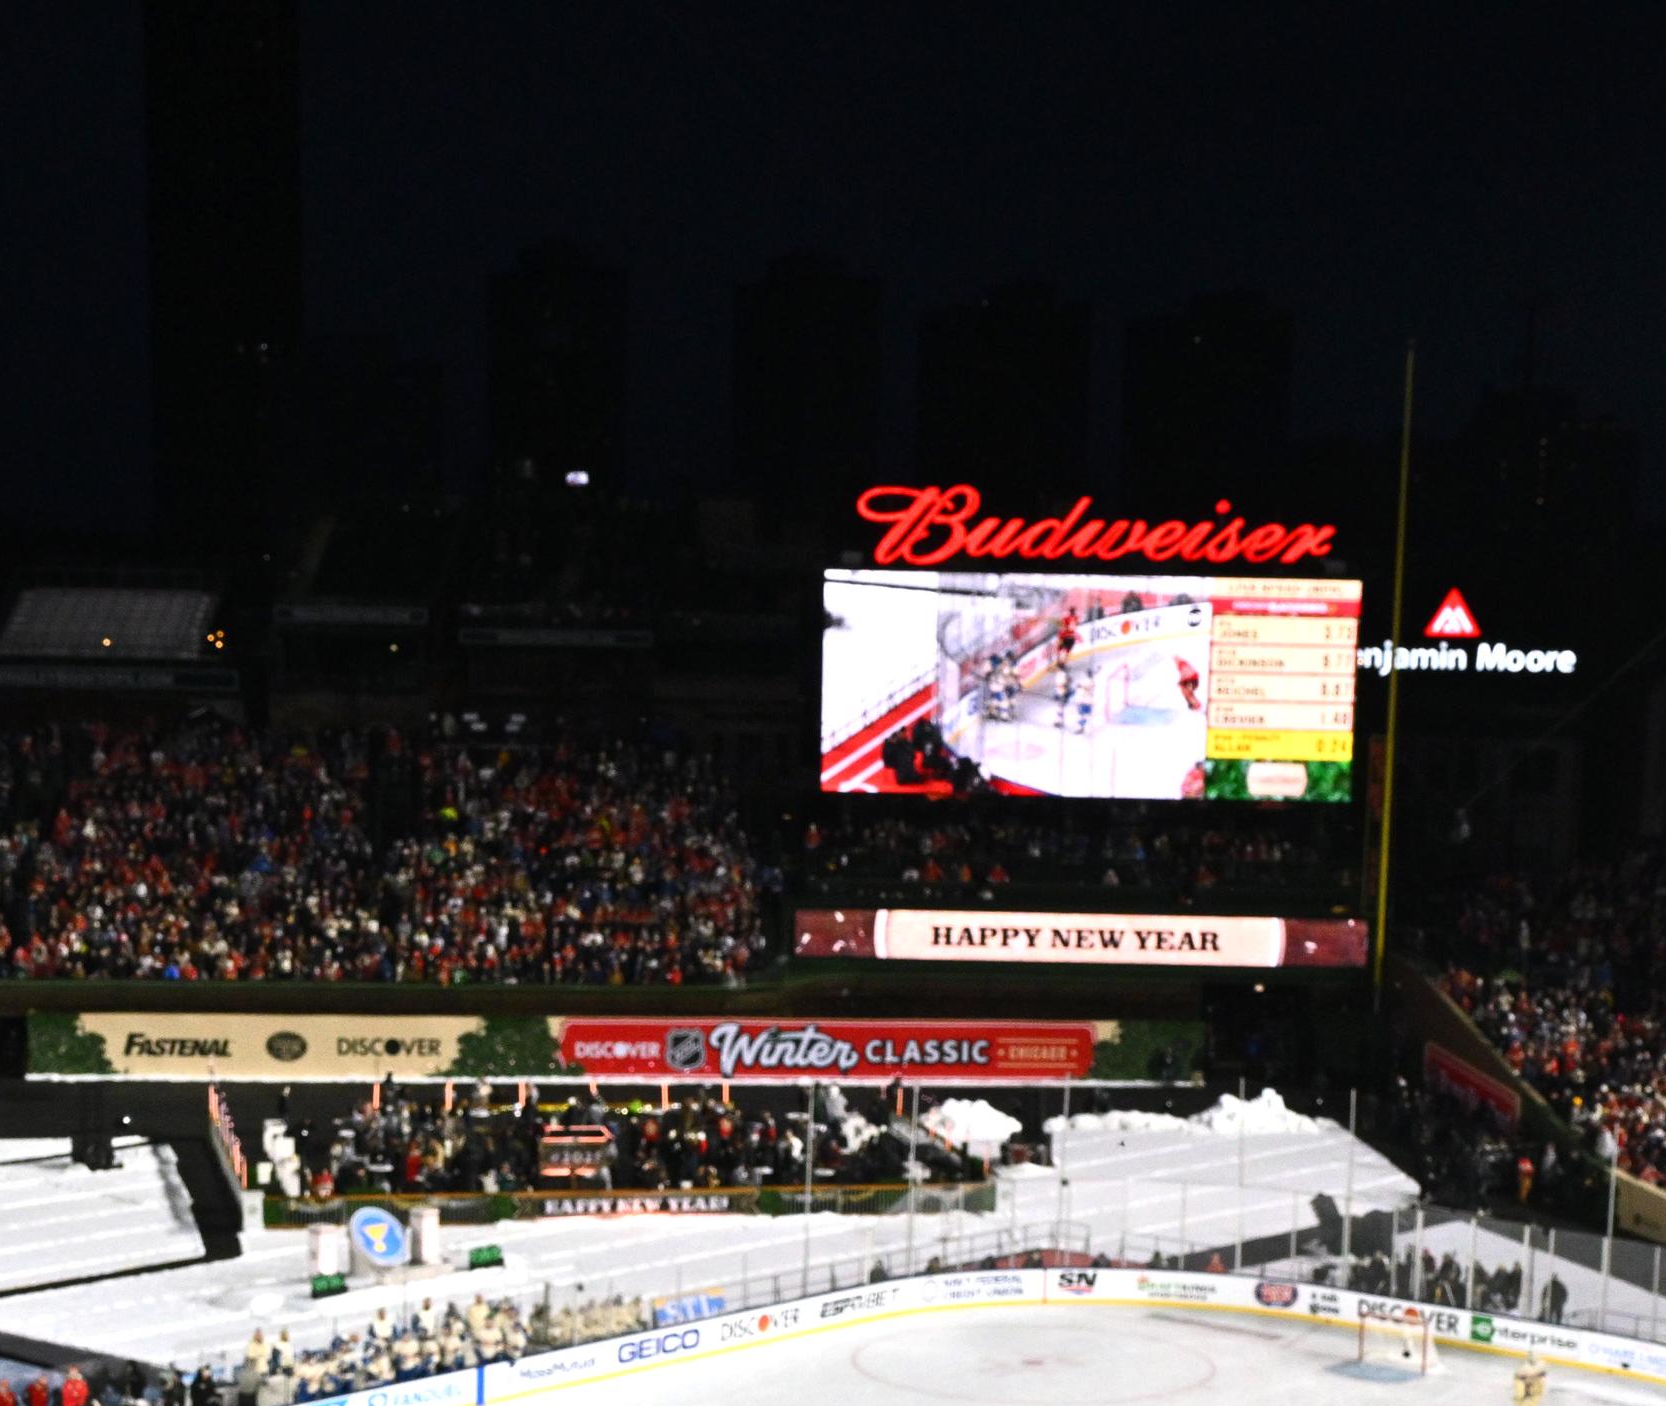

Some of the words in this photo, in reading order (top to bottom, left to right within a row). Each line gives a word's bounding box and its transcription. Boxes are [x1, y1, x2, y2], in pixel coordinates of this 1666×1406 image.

[856, 484, 1335, 566] Budweiser
[1357, 640, 1467, 676] njamin
[1476, 642, 1578, 673] Moore
[931, 924, 1047, 952] HAPPY
[1050, 926, 1124, 952] NEW
[1126, 927, 1222, 953] YEAR
[123, 1033, 233, 1058] FASTENAL
[336, 1036, 443, 1057] DISCOVER
[573, 1041, 662, 1060] DISCOVER
[709, 1022, 860, 1078] Winter
[864, 1039, 990, 1064] CLASSIC
[1057, 1272, 1099, 1288] SN
[720, 1307, 801, 1342] DISCOVER
[1356, 1298, 1461, 1335] DISCOVER
[617, 1328, 701, 1364] GEICO
